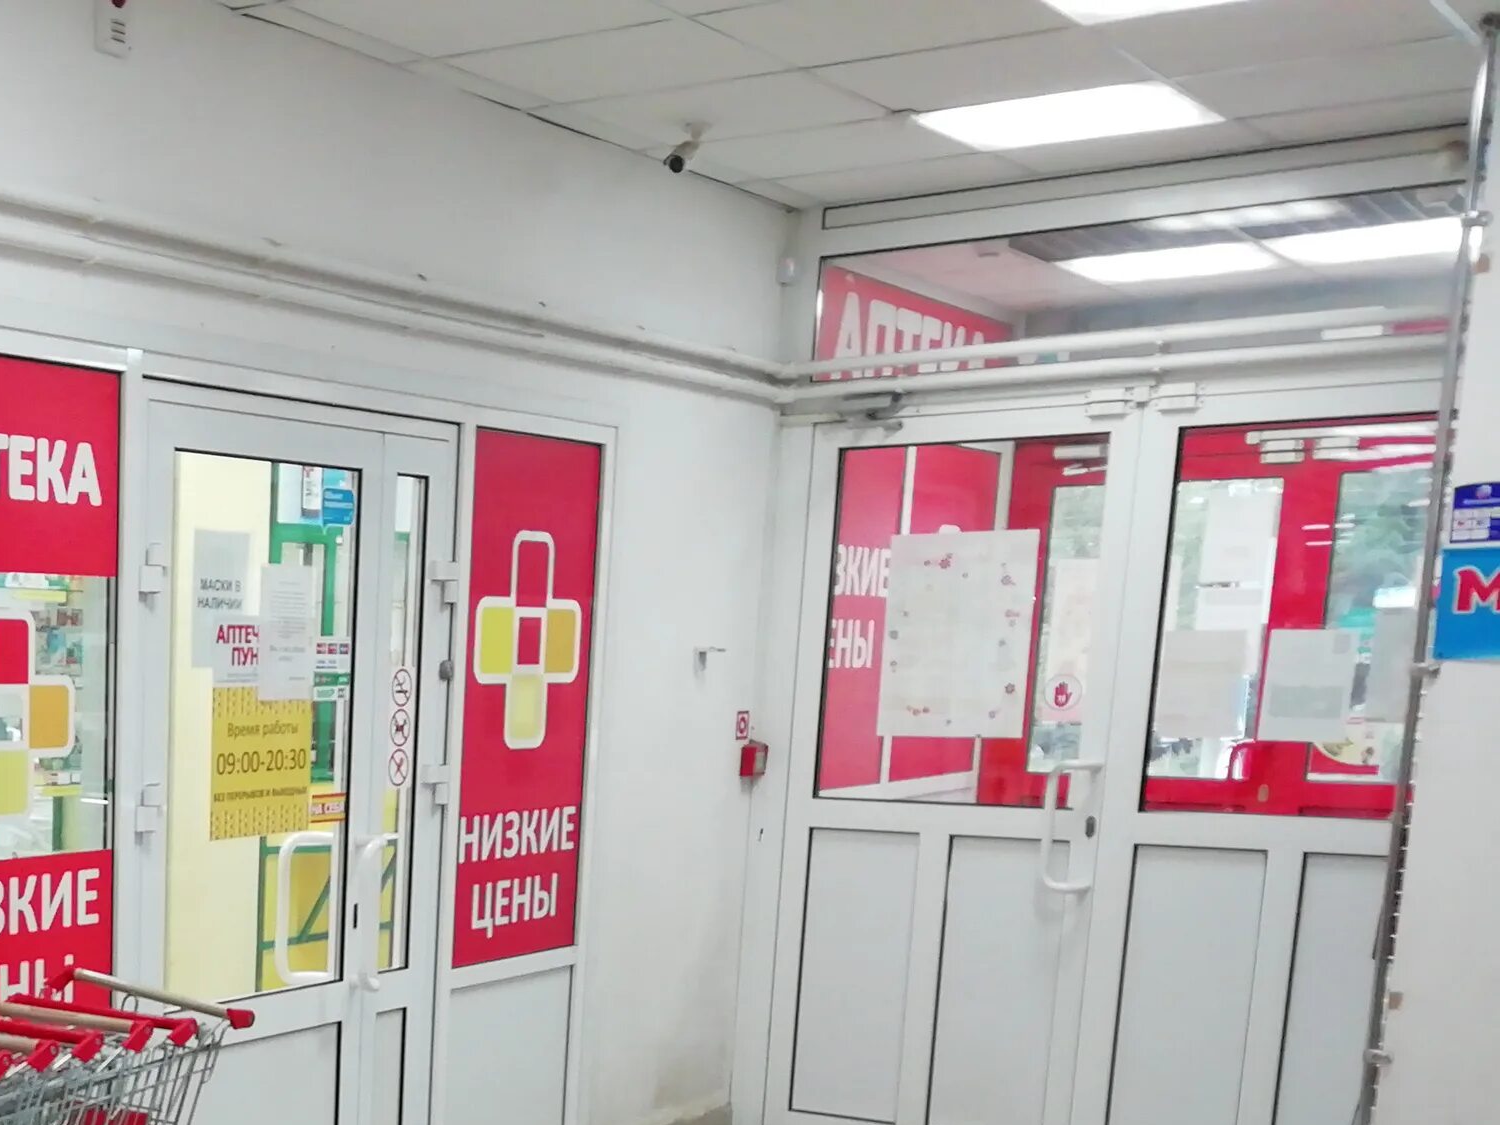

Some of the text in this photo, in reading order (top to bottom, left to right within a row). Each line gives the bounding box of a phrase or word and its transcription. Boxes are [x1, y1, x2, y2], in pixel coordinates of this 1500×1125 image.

[199, 577, 242, 593] МАСКИ В
[196, 596, 243, 611] НАЛИЧИИ
[227, 720, 299, 740] Время работы
[215, 748, 308, 776] 09:00-20:30
[457, 805, 577, 865] НИЗКИЕ
[470, 872, 559, 939] ЦЕНЫ
